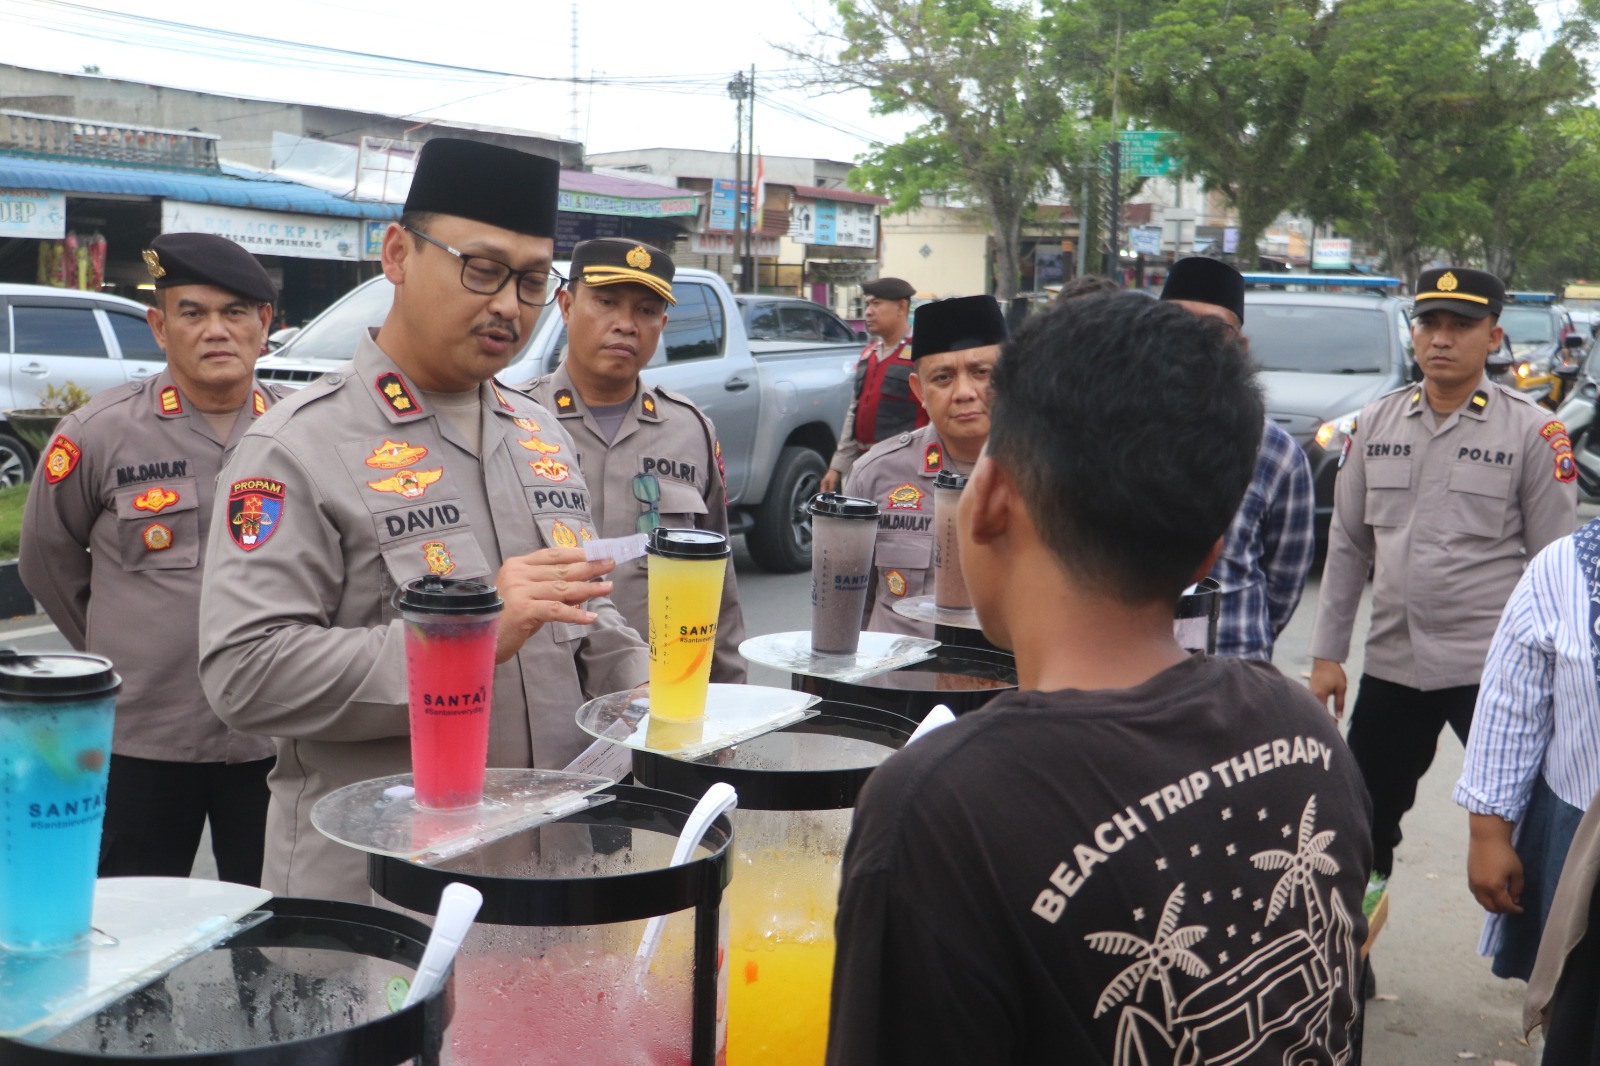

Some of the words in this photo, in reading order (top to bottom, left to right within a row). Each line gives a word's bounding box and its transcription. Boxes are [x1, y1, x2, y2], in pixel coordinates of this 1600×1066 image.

[275, 239, 322, 249] MINANG
[1458, 447, 1513, 465] POLRI
[643, 457, 695, 483] POLRI
[234, 480, 282, 493] PROPAM
[534, 490, 586, 512] POLRI
[385, 503, 460, 537] DAVID
[1031, 806, 1147, 924] BEACH
[1140, 770, 1211, 822] TRIP
[1211, 735, 1332, 788] THERAPY
